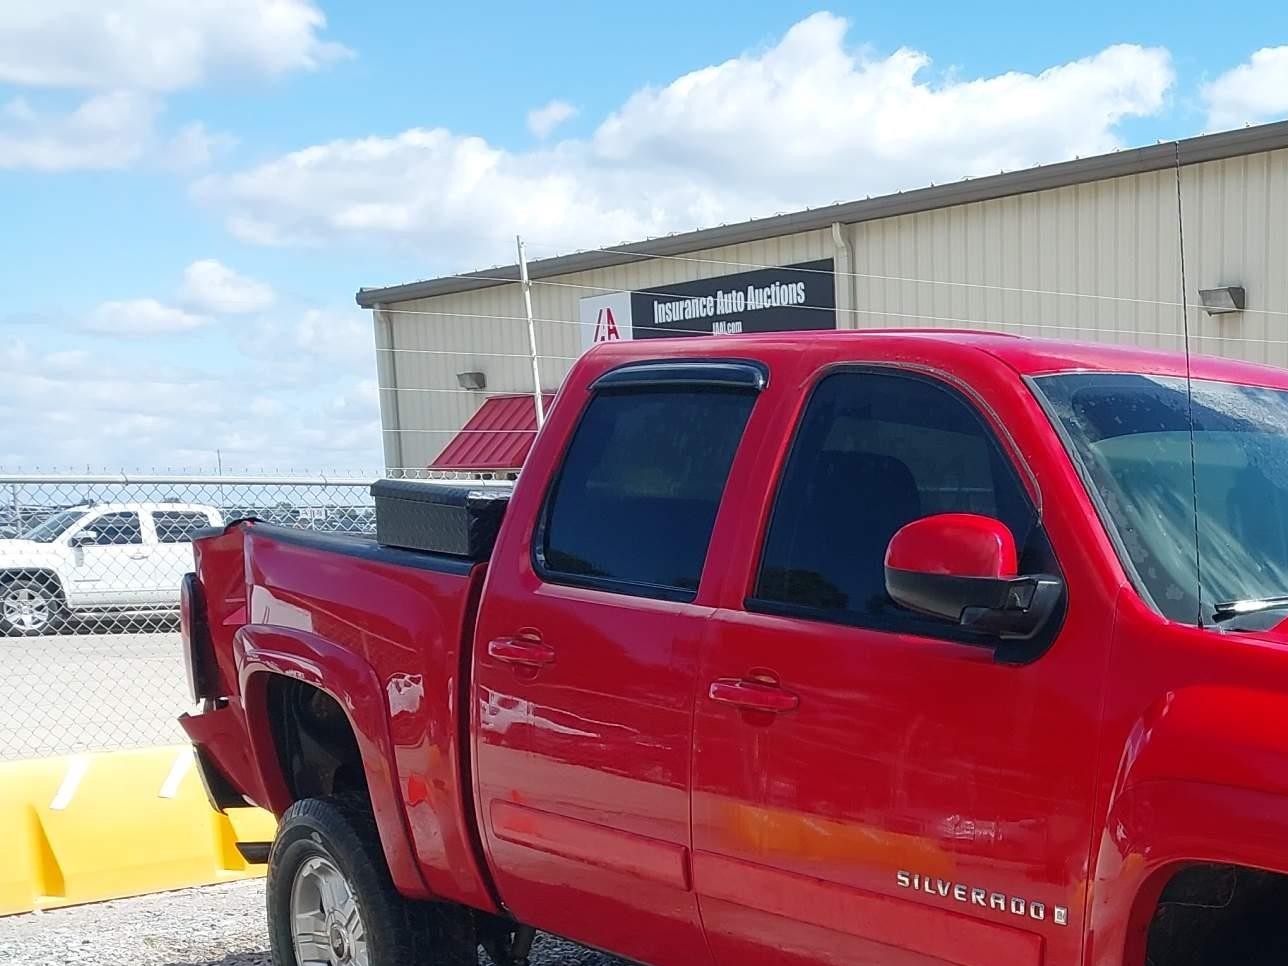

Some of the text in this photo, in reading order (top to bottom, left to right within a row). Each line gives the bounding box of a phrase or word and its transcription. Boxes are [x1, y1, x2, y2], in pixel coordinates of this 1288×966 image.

[653, 281, 805, 324] Insurance Auto Auctions
[896, 870, 1045, 921] SILVERADO
